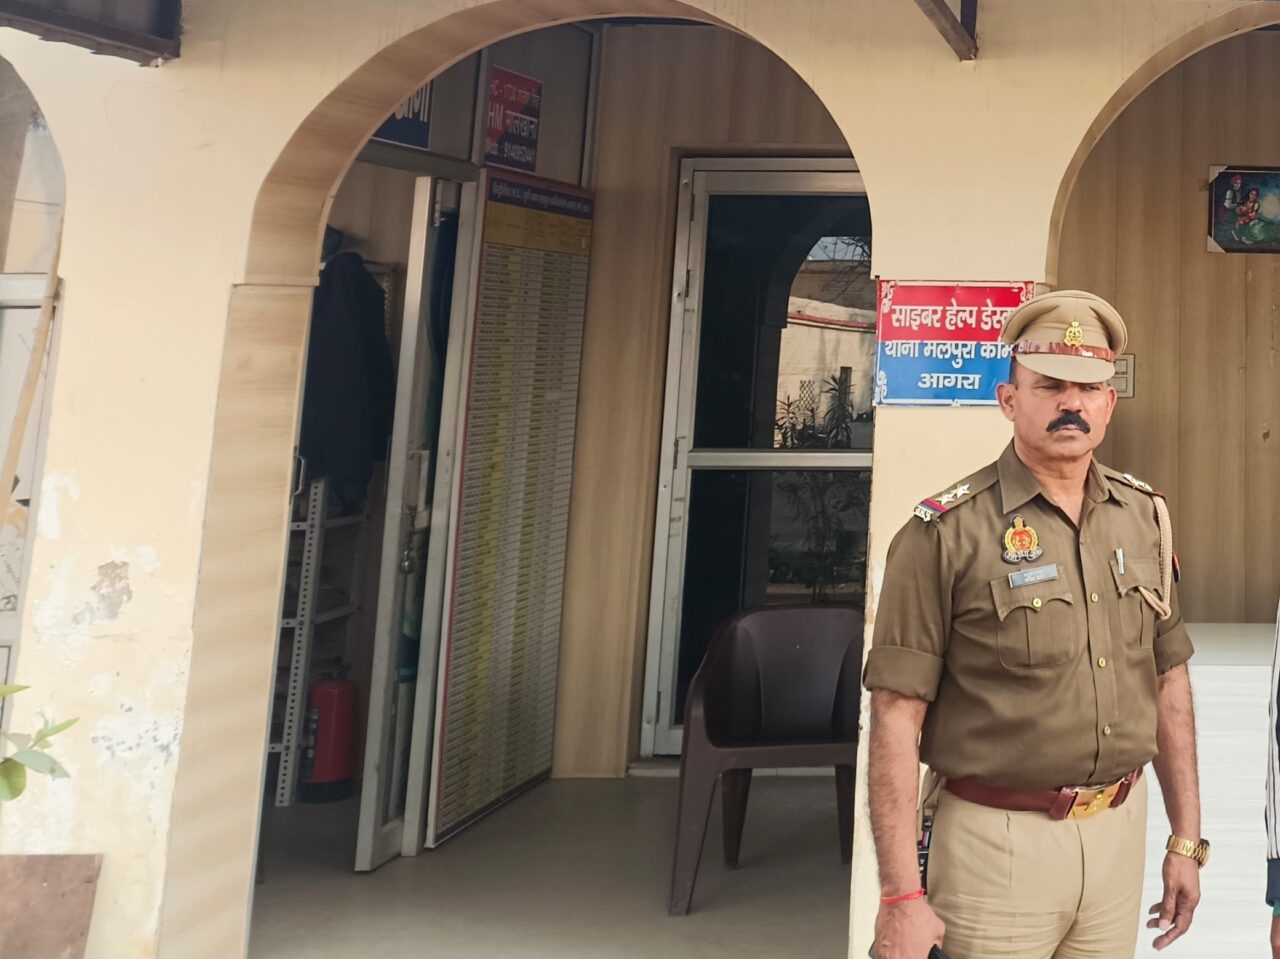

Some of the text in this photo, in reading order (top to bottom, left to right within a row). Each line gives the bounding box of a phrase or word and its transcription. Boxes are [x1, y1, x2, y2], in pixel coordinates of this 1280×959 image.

[891, 304, 942, 331] साइबर
[944, 298, 978, 329] हेल्प
[884, 339, 918, 358] थाना
[922, 339, 976, 369] मलपुरा
[917, 372, 981, 390] आगरा
